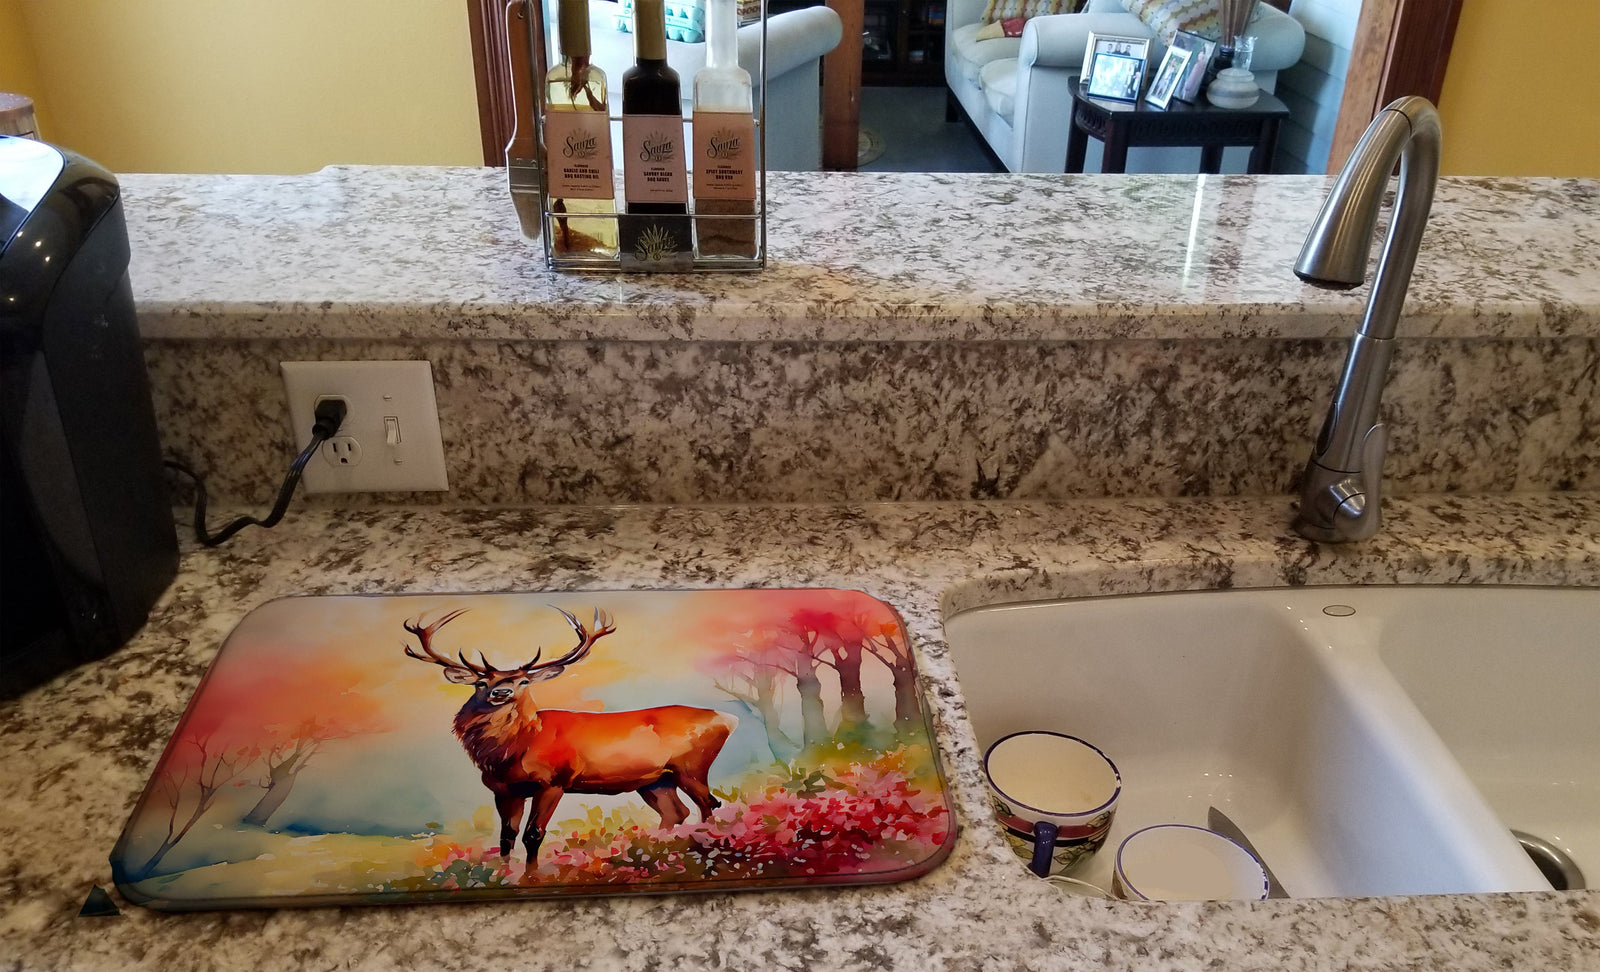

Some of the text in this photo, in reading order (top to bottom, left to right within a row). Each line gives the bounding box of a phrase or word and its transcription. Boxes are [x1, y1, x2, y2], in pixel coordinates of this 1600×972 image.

[563, 136, 597, 158] Sauza
[640, 140, 673, 162] Sauza
[707, 136, 740, 159] Sauza
